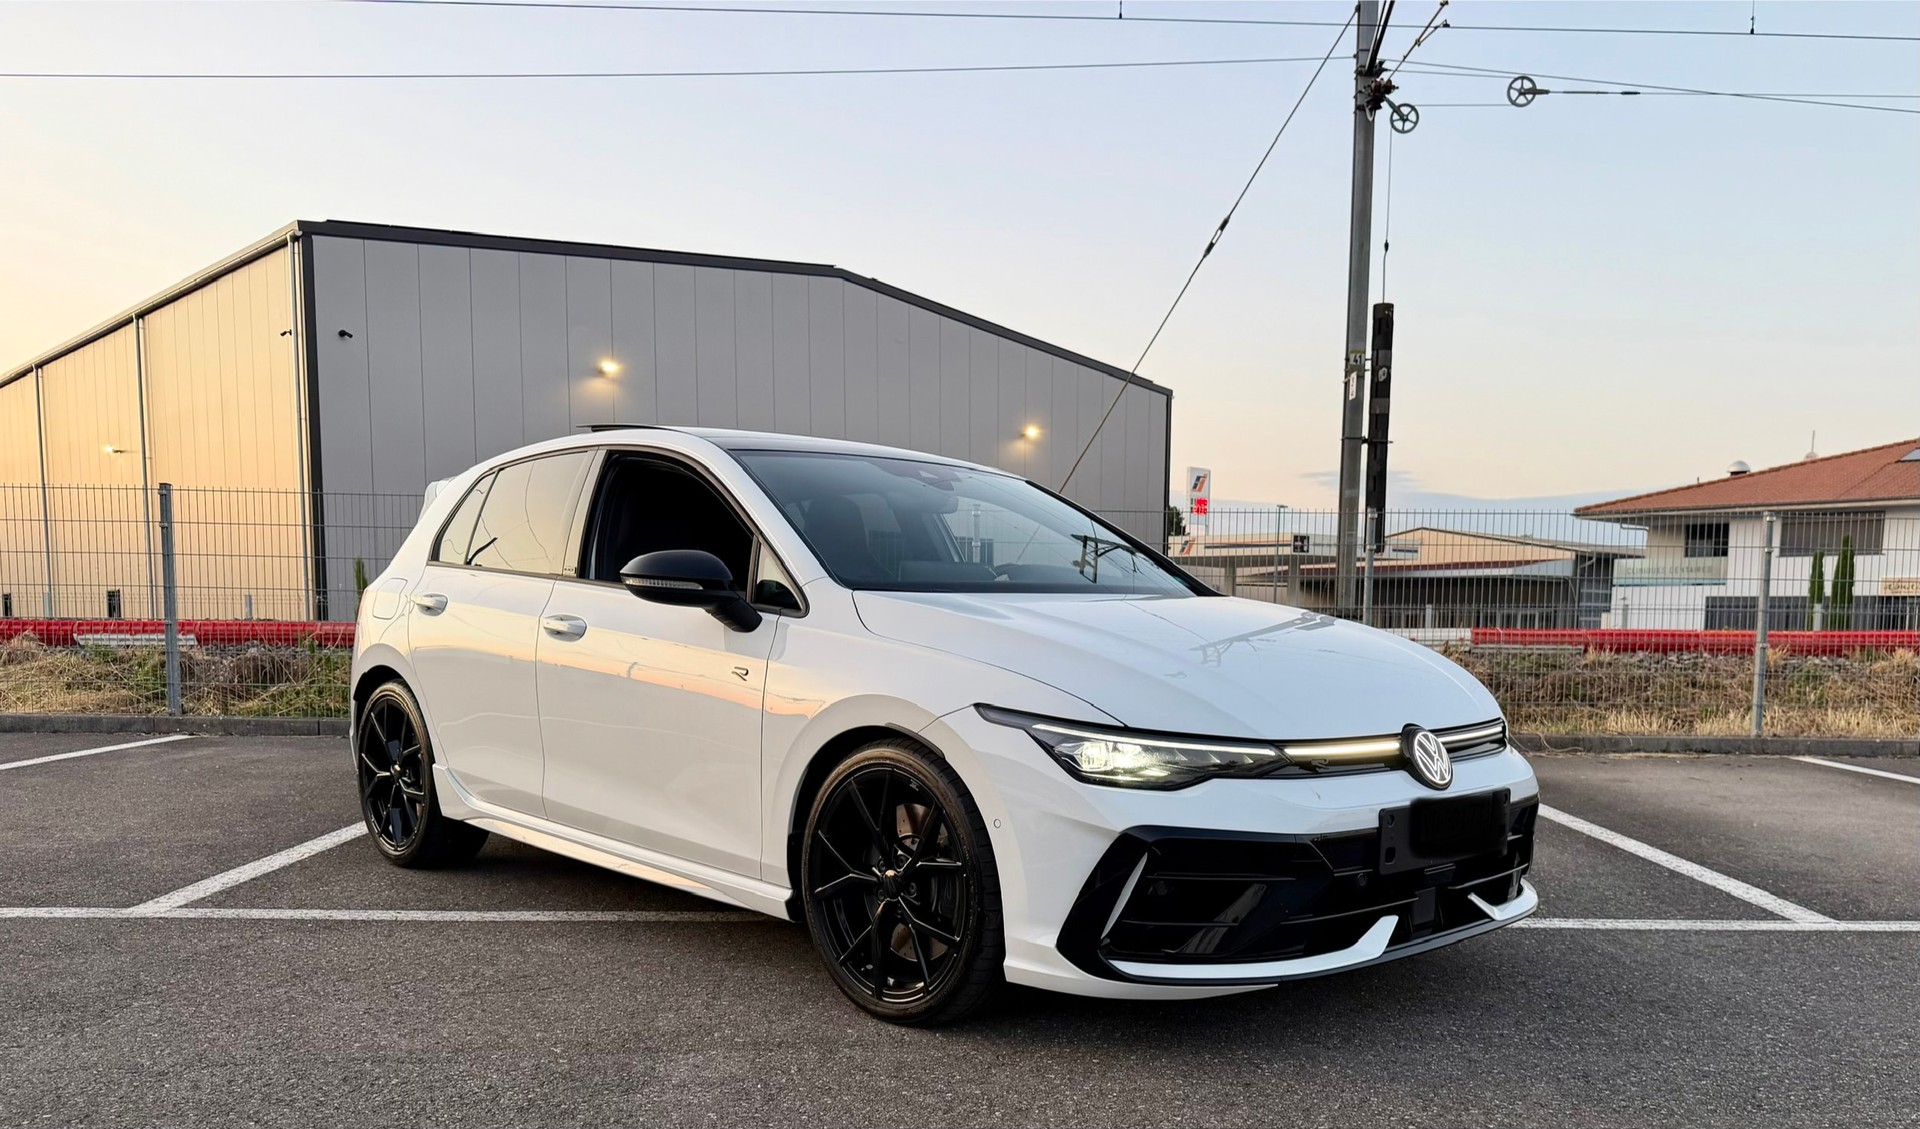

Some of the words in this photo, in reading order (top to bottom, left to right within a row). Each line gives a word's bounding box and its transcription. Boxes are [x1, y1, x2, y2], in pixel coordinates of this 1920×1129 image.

[1353, 354, 1362, 364] 41
[731, 666, 749, 682] R
[1414, 731, 1451, 784] VW
